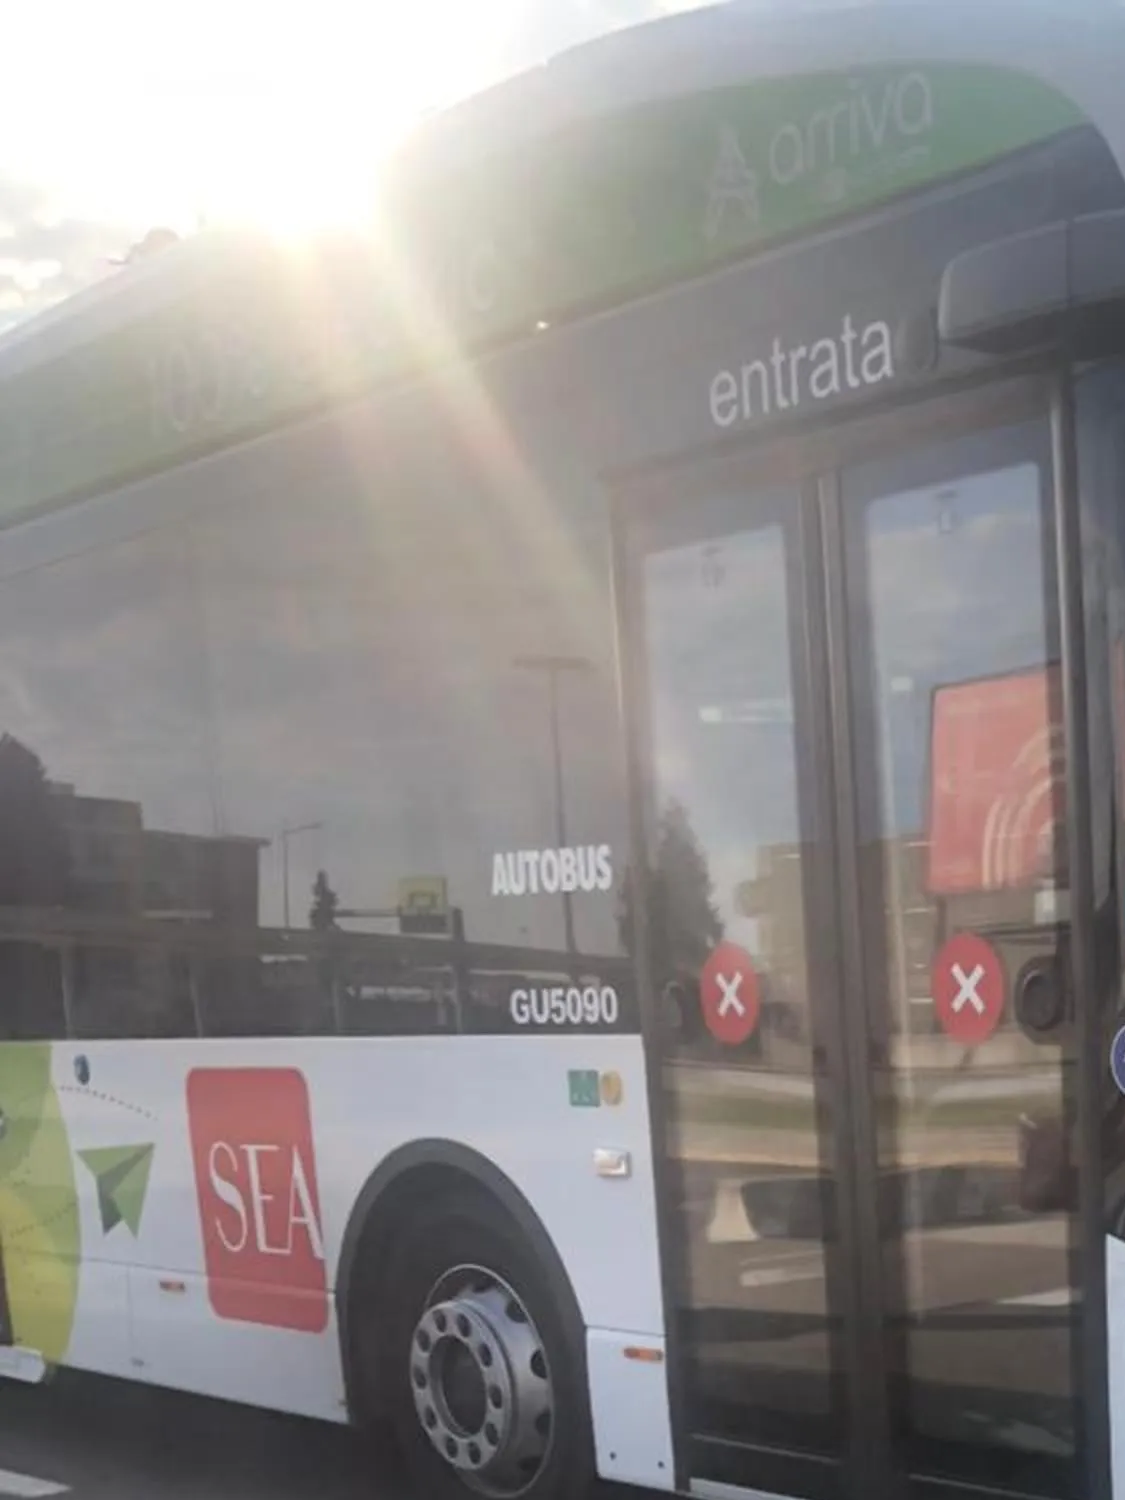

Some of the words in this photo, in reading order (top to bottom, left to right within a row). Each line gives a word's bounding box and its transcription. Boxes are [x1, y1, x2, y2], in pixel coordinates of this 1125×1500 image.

[768, 70, 934, 186] arriva
[708, 312, 894, 427] entrata
[491, 844, 613, 897] AUTOBUS
[509, 985, 619, 1025] GU5090
[208, 1140, 326, 1260] SEA
